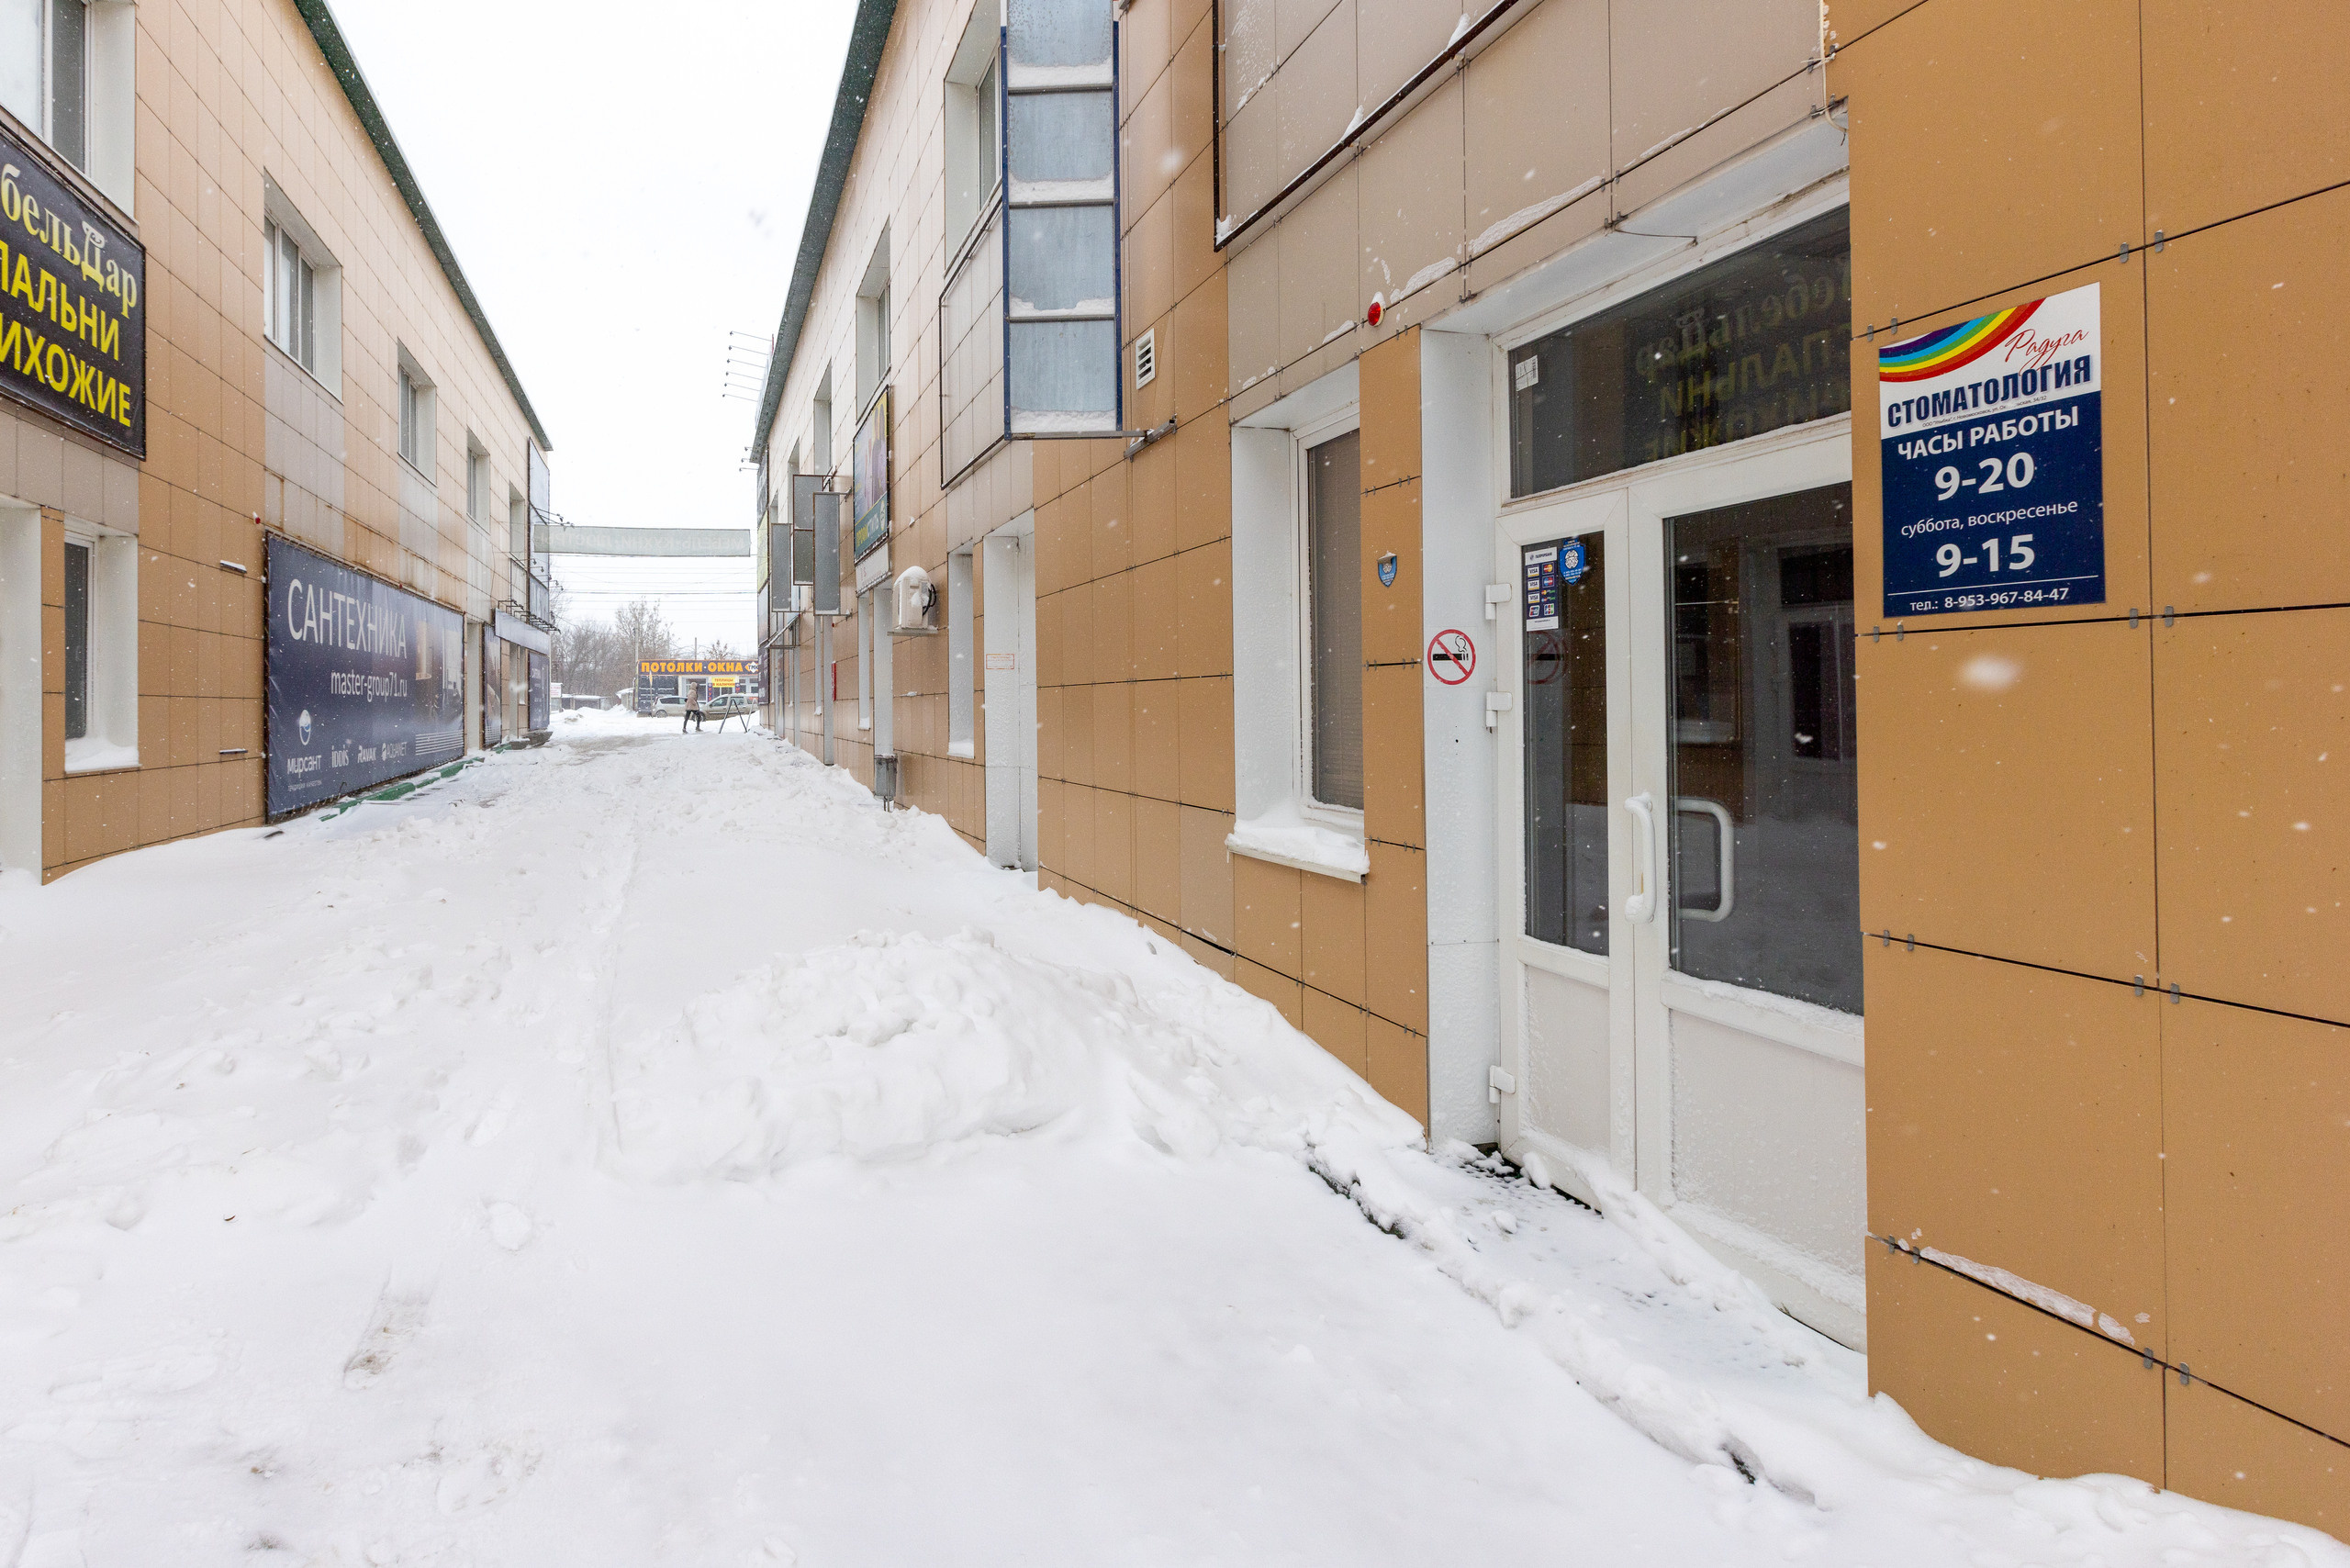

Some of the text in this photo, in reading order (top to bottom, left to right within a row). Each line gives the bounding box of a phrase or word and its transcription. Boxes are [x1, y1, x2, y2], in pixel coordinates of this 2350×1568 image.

[2005, 329, 2089, 376] Радуга
[1887, 354, 2091, 429] СТОМАТОЛОГИЯ
[1897, 406, 2079, 460] ЧАСЫ РАБОТЫ
[1934, 452, 2035, 502] 9-20
[1901, 500, 2078, 538] суббота, воскресенье
[1936, 533, 2035, 578] 9-15
[288, 578, 407, 658] САНТЕХНИКА
[1910, 588, 2070, 612] тел.: 8-953-967-84-47
[331, 669, 407, 702] master-group71.ru
[642, 662, 703, 673] ПОТОЛКИ
[708, 662, 744, 673] ОКНА
